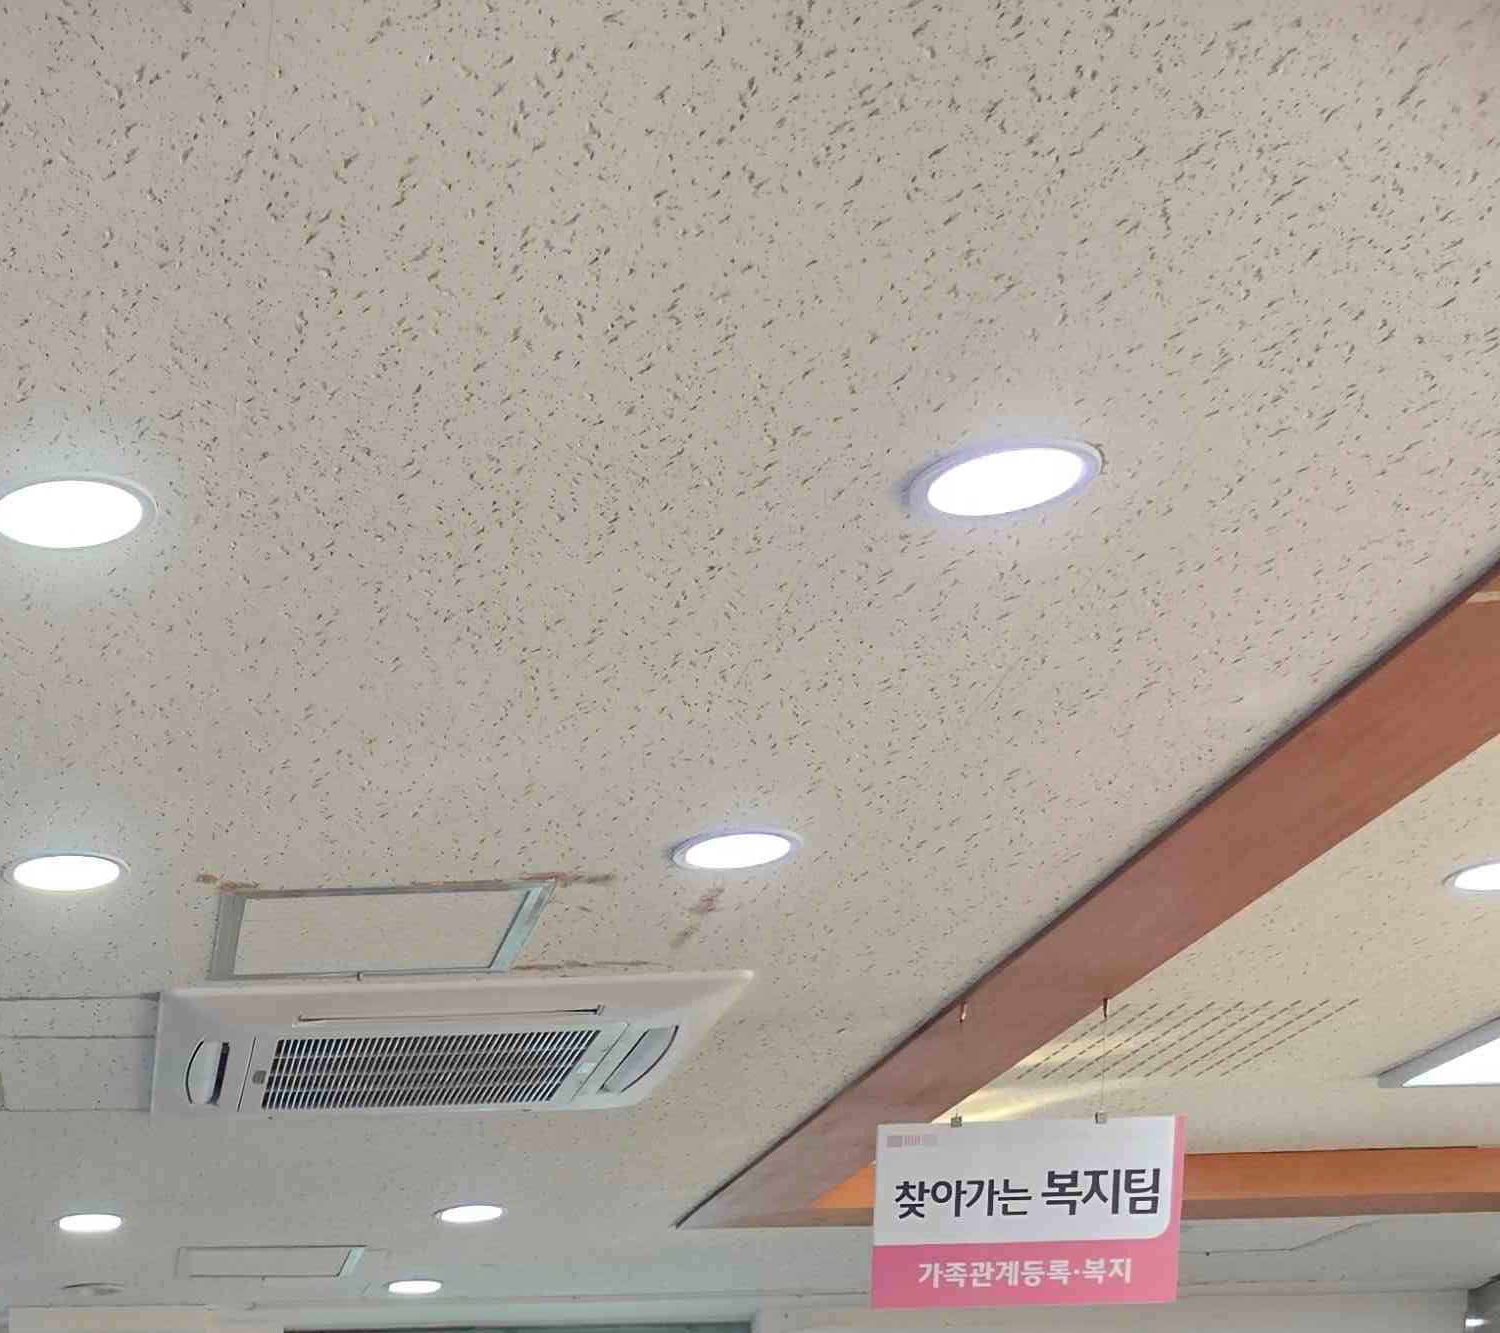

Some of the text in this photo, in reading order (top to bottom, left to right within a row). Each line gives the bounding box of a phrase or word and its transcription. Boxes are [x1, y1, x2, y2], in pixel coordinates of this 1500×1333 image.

[895, 1167, 1160, 1219] 찾아가는 복지팀
[918, 1258, 1132, 1288] 가족관계등록·복지
